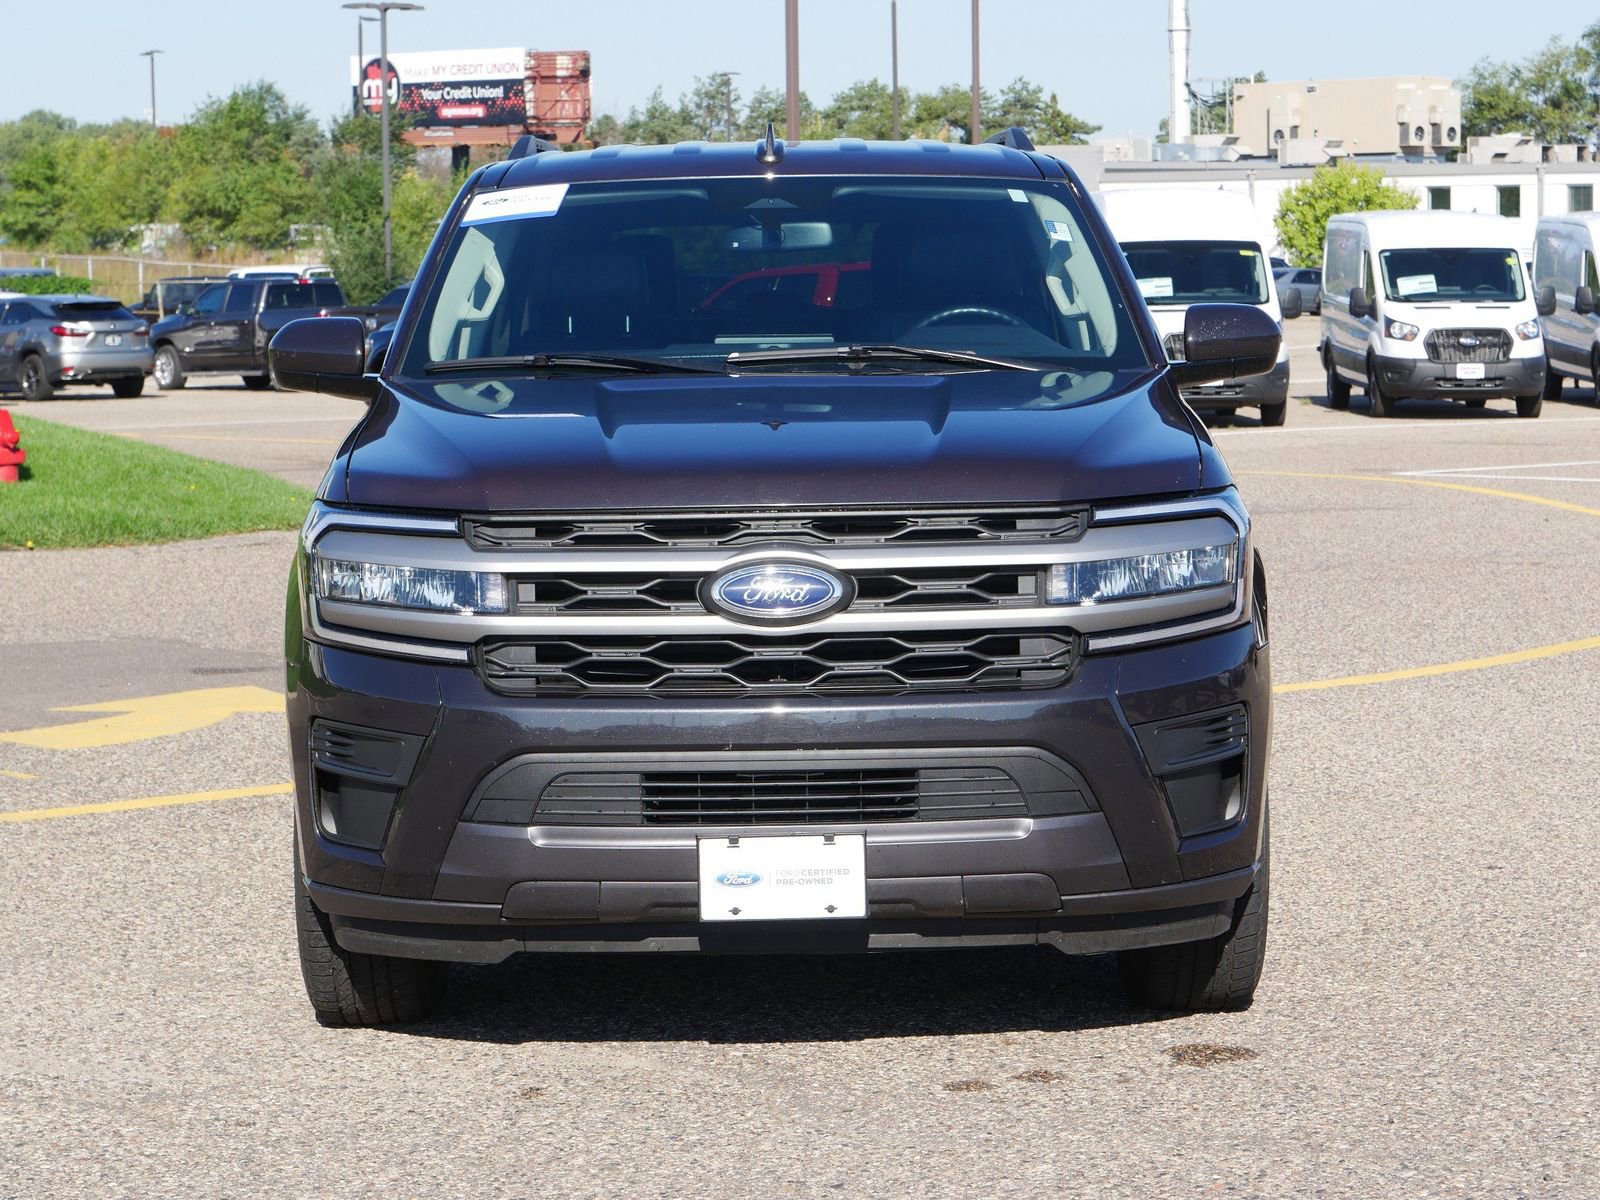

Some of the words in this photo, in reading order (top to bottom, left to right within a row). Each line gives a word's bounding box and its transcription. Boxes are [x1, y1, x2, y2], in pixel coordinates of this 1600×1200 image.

[432, 65, 447, 75] MY
[450, 64, 484, 75] CREDIT
[486, 62, 520, 73] UNION
[421, 89, 443, 100] Your
[443, 86, 472, 99] Credit
[743, 576, 810, 604] Ford
[723, 873, 753, 885] Ford
[776, 877, 833, 886] PRE-OWNED
